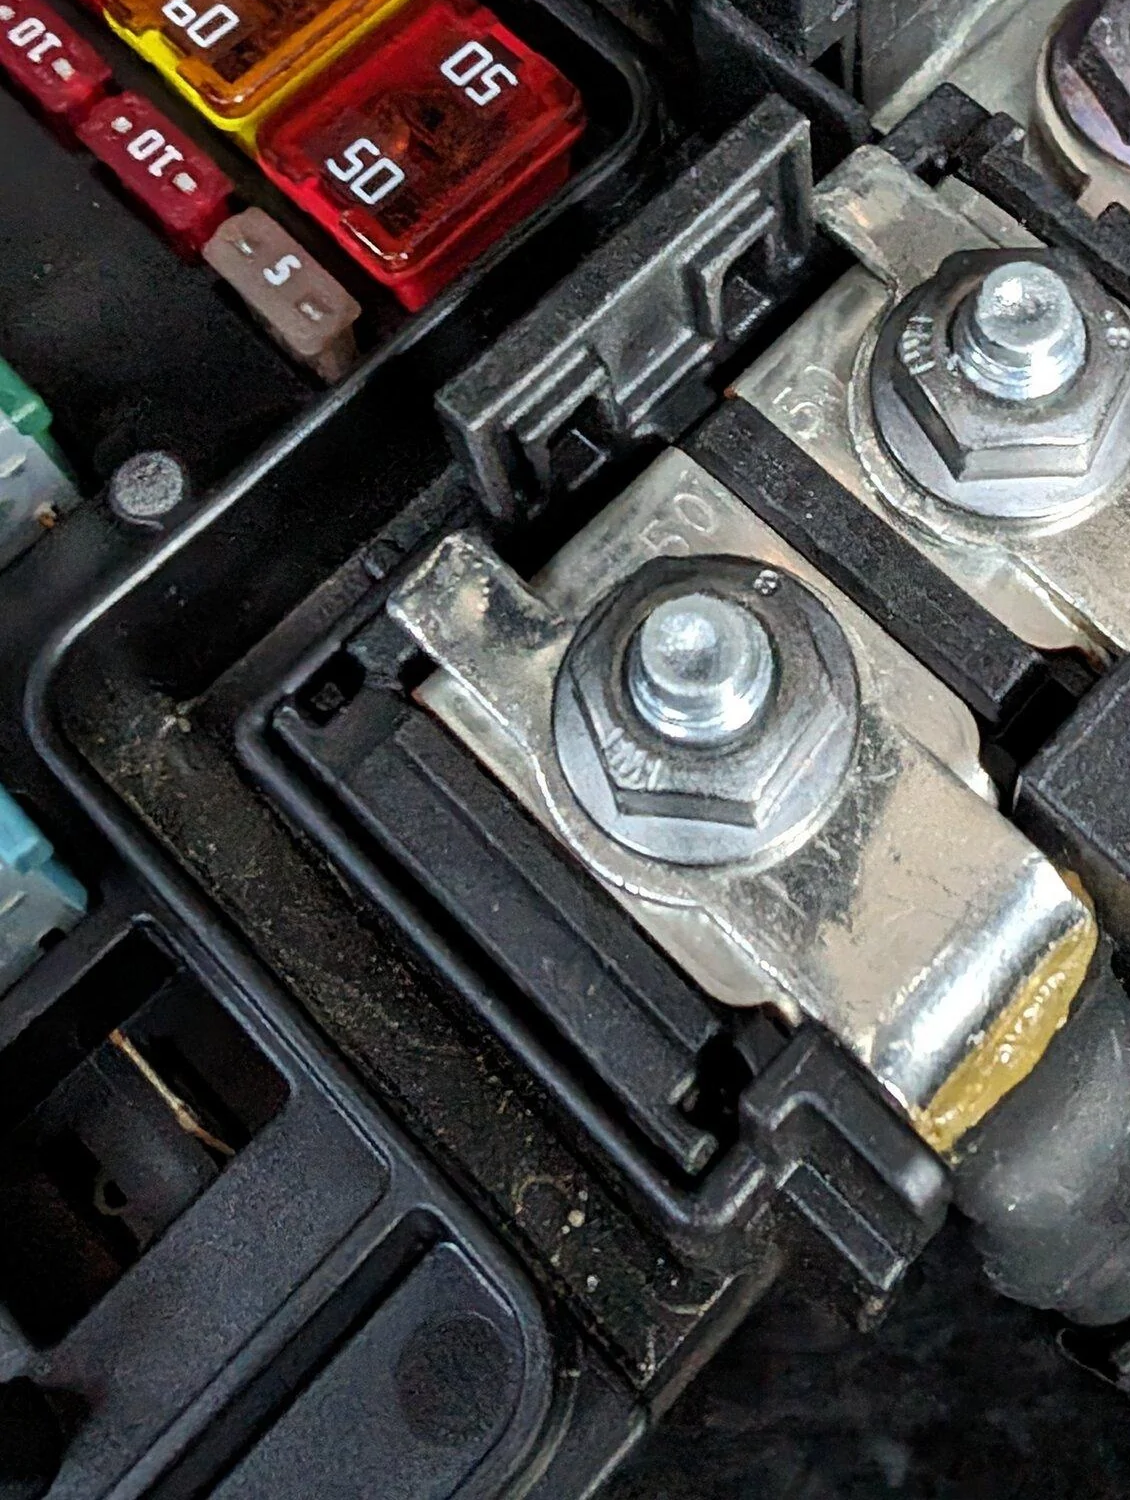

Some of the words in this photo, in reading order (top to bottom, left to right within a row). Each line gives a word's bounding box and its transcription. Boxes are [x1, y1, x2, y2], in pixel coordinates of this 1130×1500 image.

[439, 40, 520, 106] 50
[326, 138, 407, 206] 50
[262, 253, 302, 286] 5
